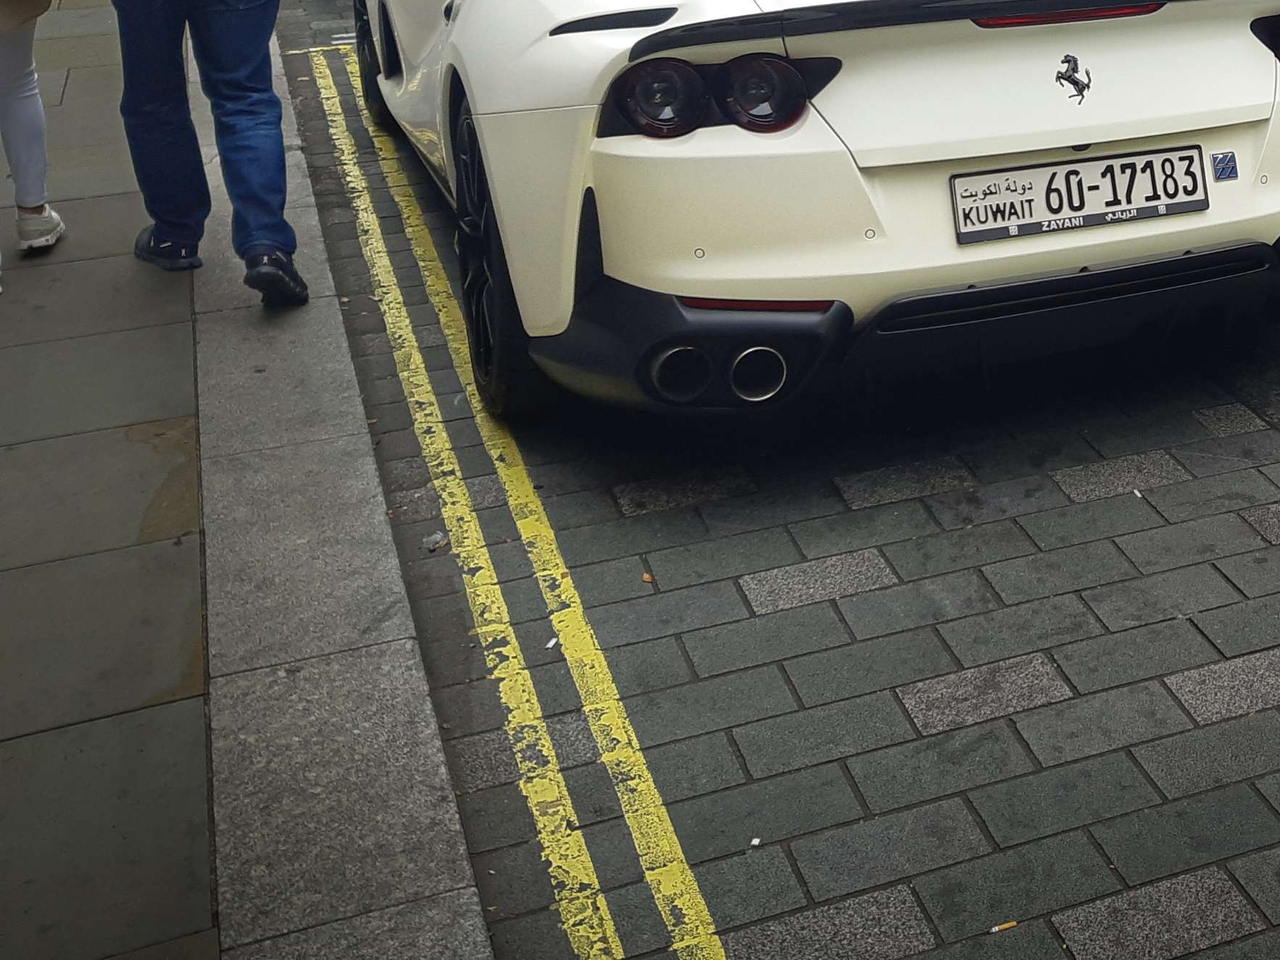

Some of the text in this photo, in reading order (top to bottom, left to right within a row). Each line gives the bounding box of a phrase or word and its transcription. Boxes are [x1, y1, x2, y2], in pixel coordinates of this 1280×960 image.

[960, 176, 1033, 203] دولة الكويت
[1045, 155, 1199, 215] 60-17183
[962, 198, 1035, 227] KUWAIT
[1041, 217, 1084, 231] ZAYANI
